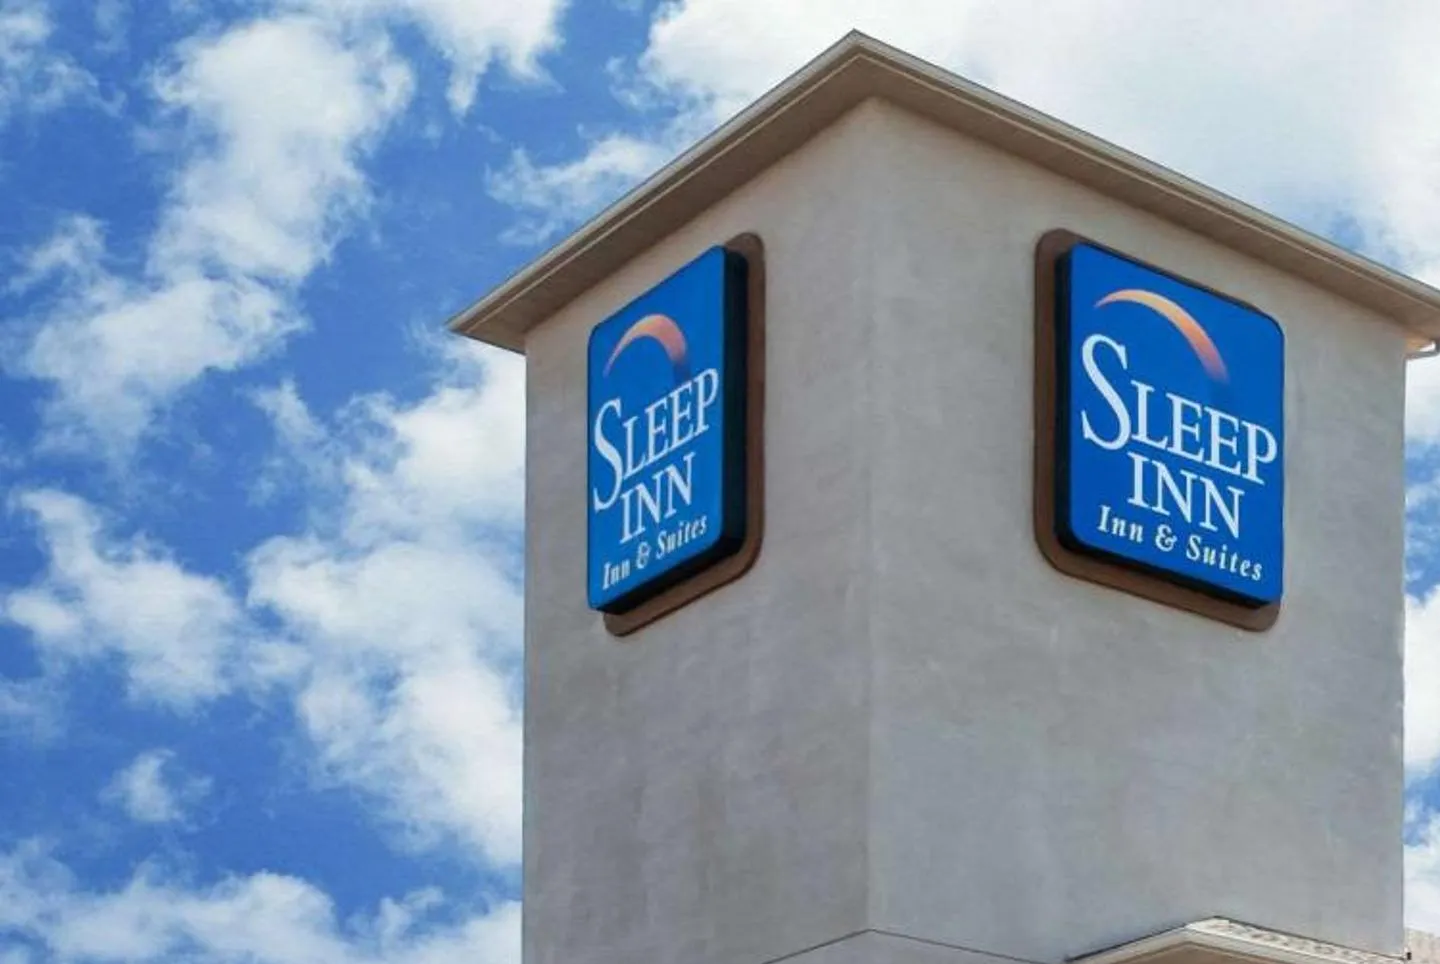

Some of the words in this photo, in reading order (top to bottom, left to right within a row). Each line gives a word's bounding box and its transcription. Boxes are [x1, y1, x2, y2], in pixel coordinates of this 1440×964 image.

[593, 367, 719, 512] SLEEP
[1080, 333, 1278, 485] SLEEP
[619, 451, 696, 545] INN
[1127, 451, 1245, 540] INN
[602, 556, 631, 590] Inn
[635, 541, 650, 569] &
[655, 514, 707, 561] Suites
[1097, 504, 1144, 544] Inn
[1154, 525, 1177, 552] &
[1185, 534, 1263, 581] Suites
